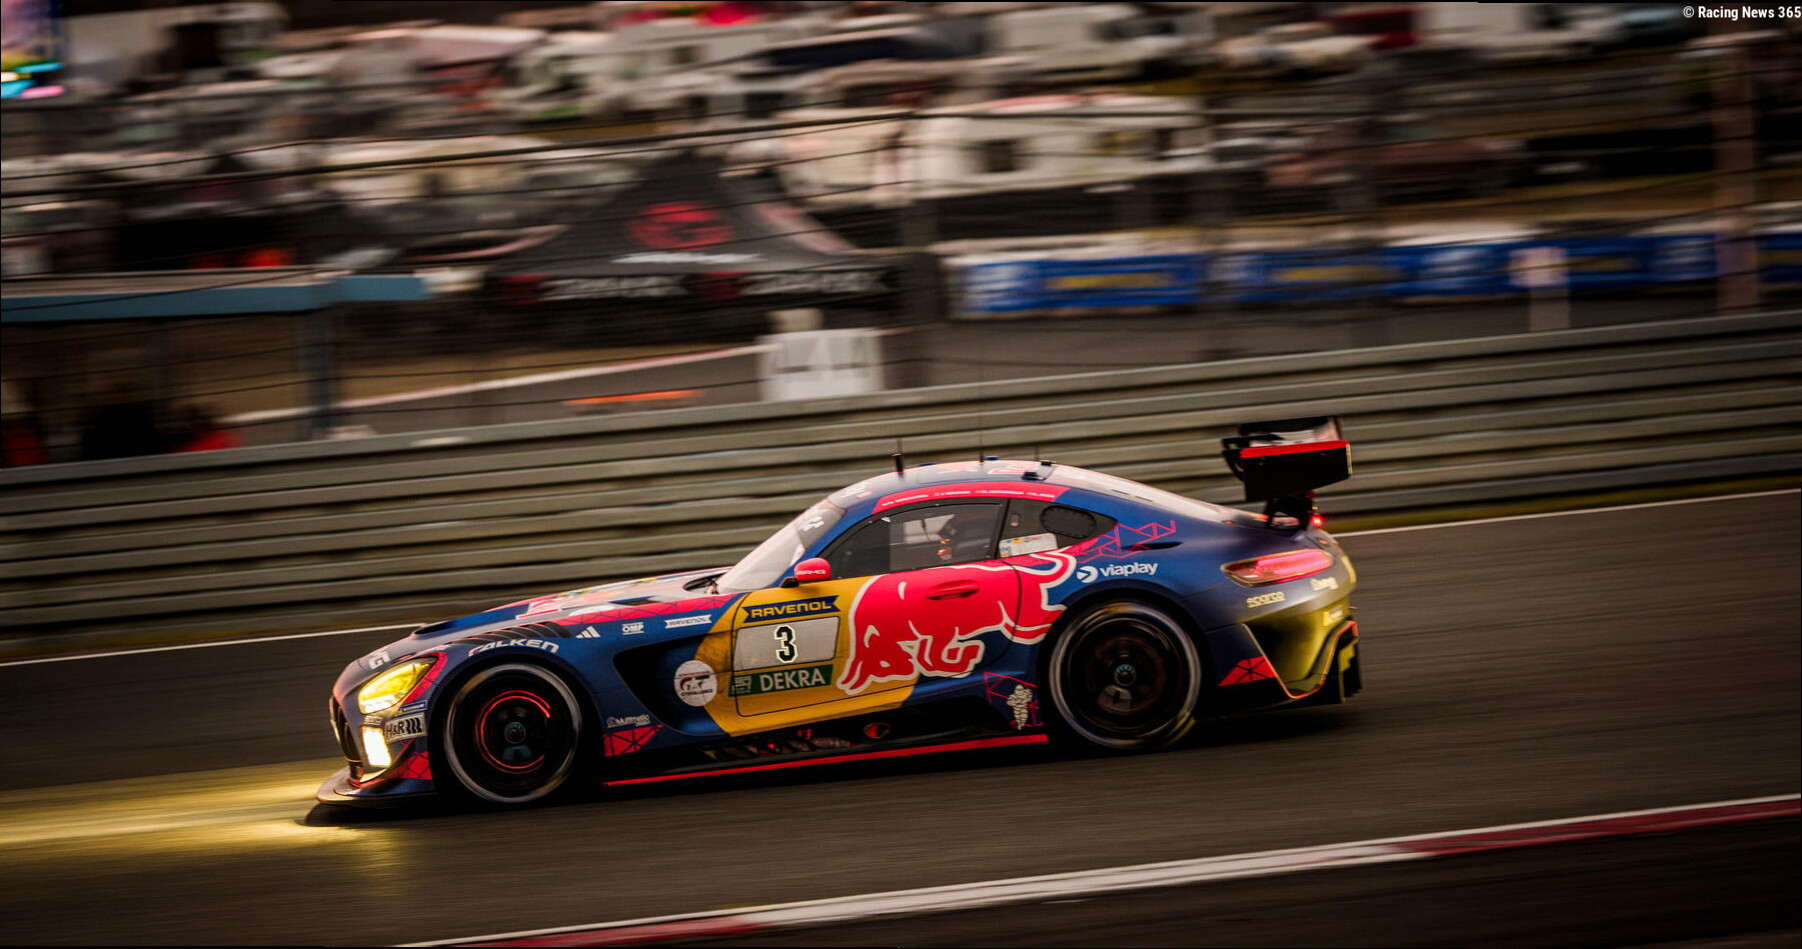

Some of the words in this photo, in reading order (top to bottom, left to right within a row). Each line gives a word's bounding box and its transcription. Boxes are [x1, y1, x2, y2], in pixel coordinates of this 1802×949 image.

[1100, 562, 1159, 577] viaplay
[751, 601, 832, 618] RAVENOL
[622, 623, 645, 633] OMP
[468, 639, 560, 657] FALKEN
[774, 625, 798, 663] 3
[760, 668, 827, 691] DEKRA
